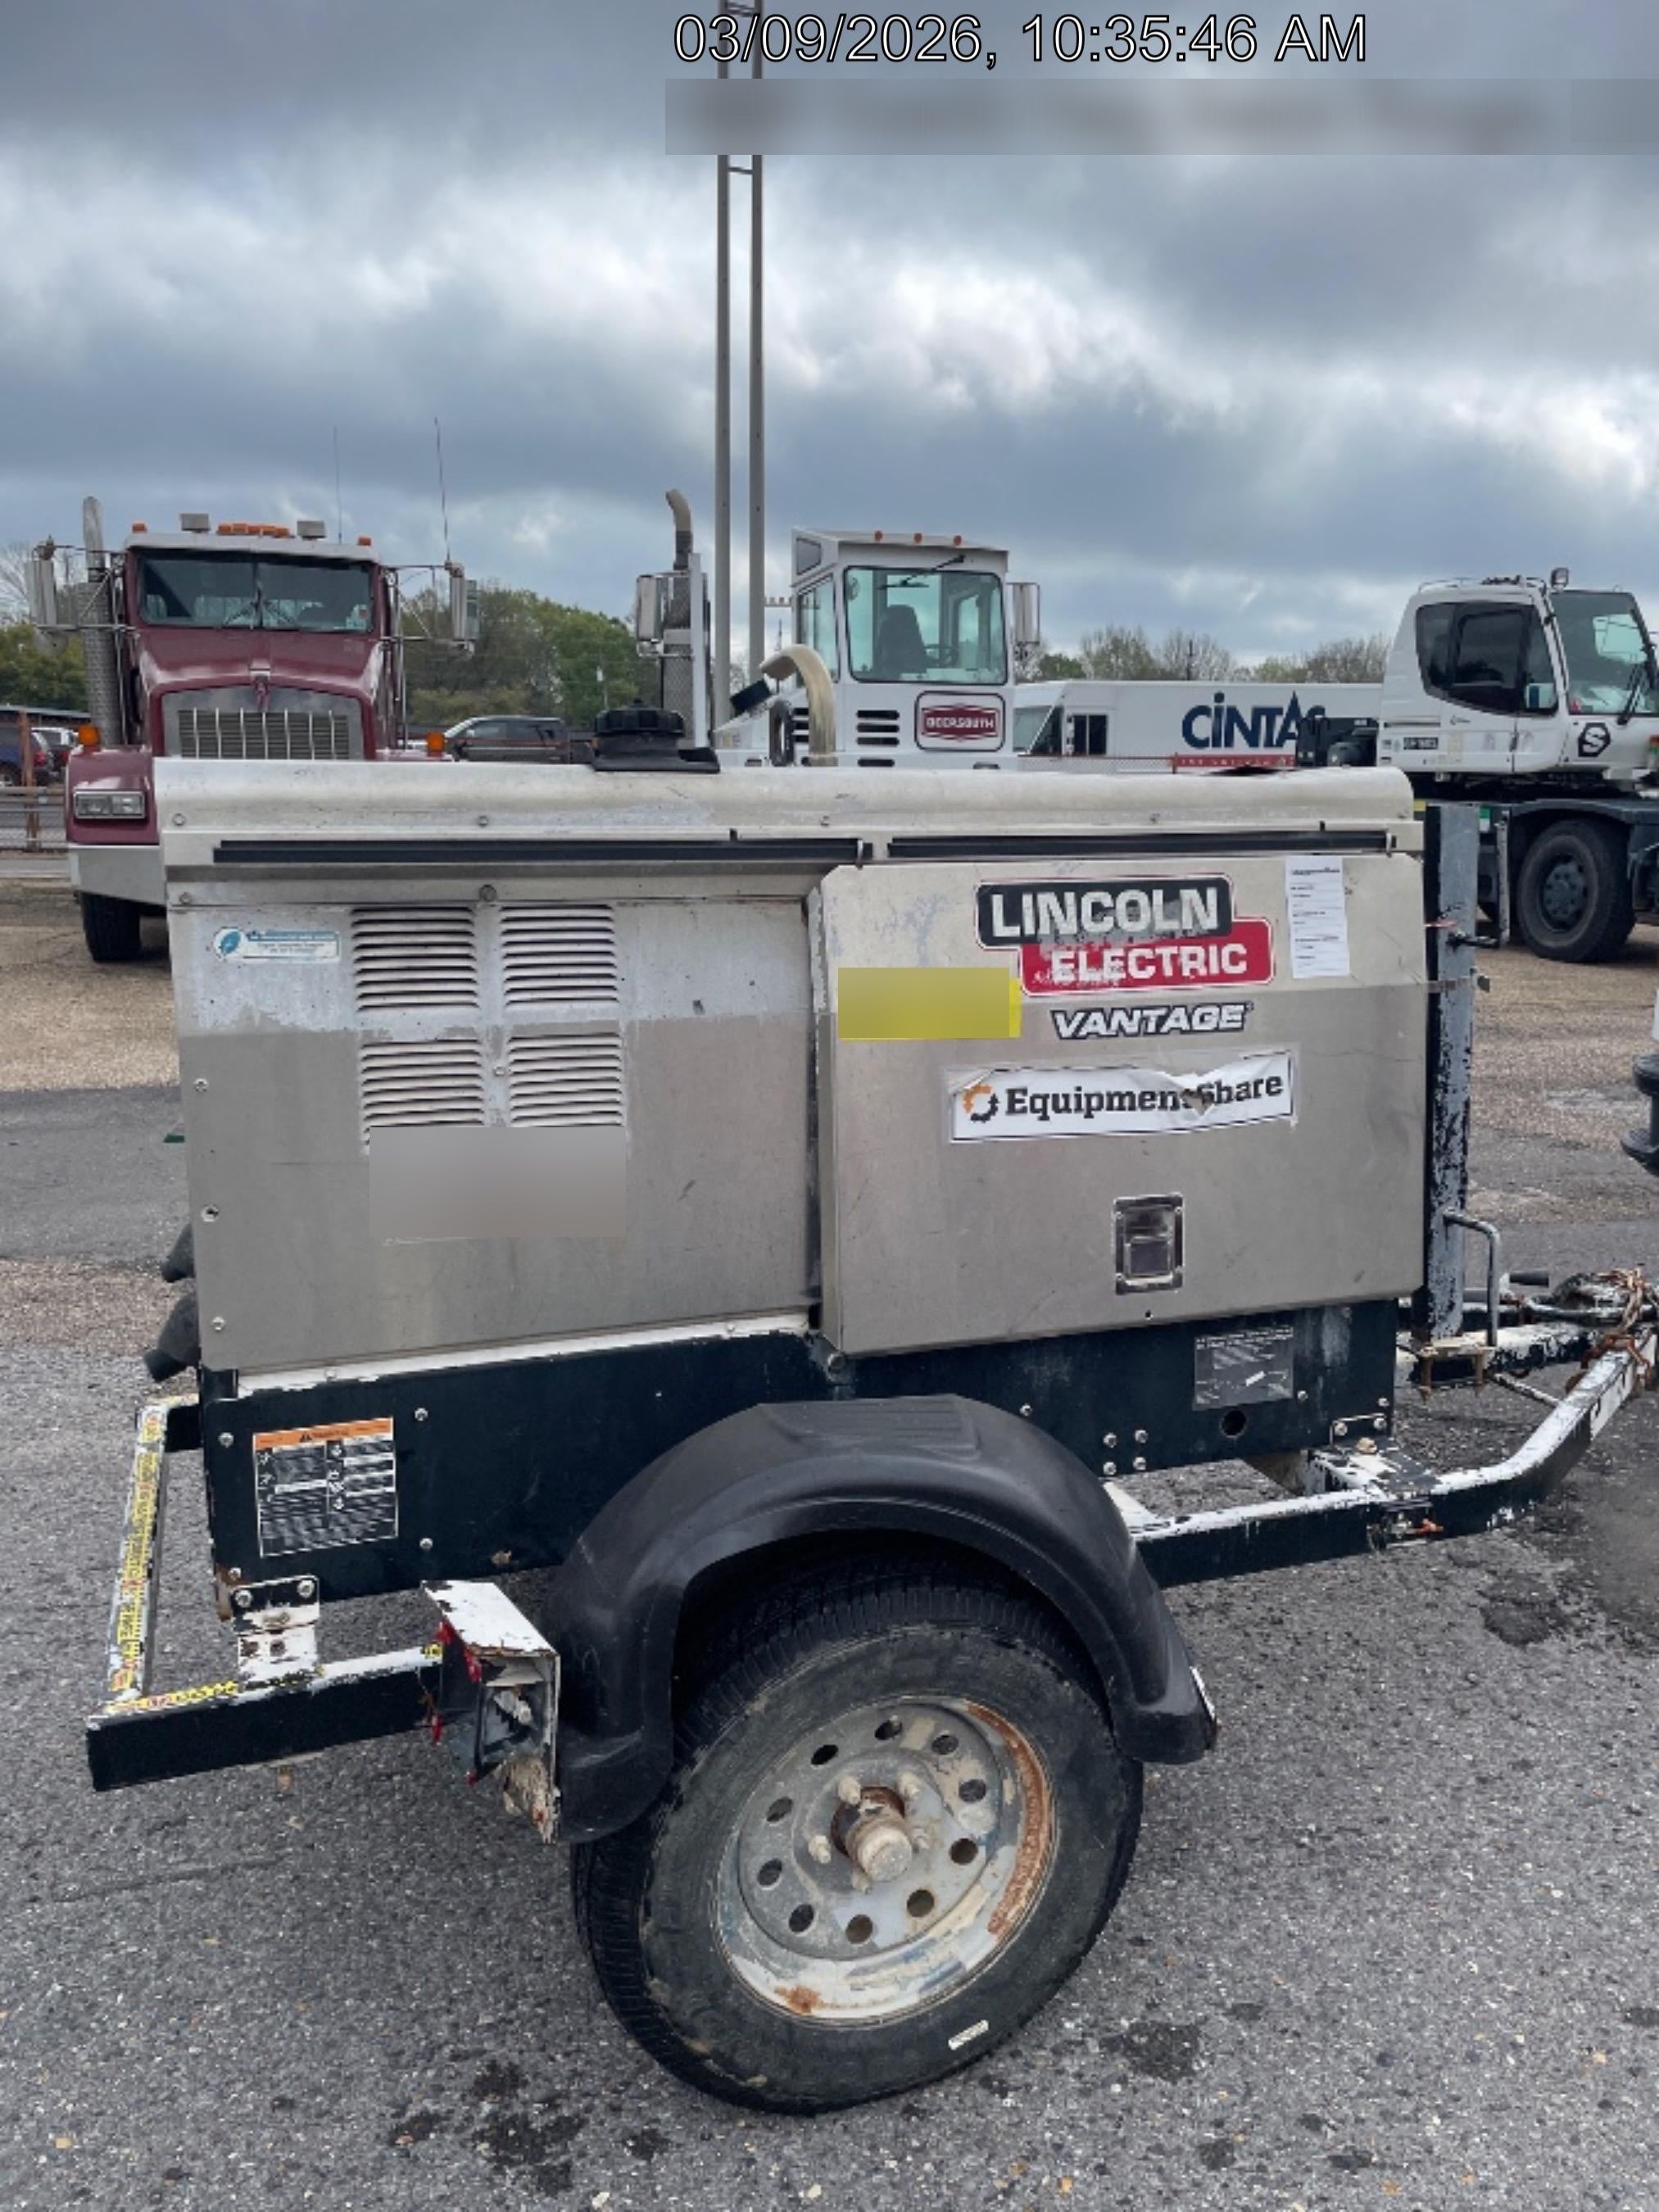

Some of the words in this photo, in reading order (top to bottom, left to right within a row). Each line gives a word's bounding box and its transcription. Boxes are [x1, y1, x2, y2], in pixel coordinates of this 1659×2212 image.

[990, 887, 1218, 937] LINCOLN
[1050, 943, 1248, 984] ELECTRIC
[1051, 1004, 1245, 1039] VANTAGE
